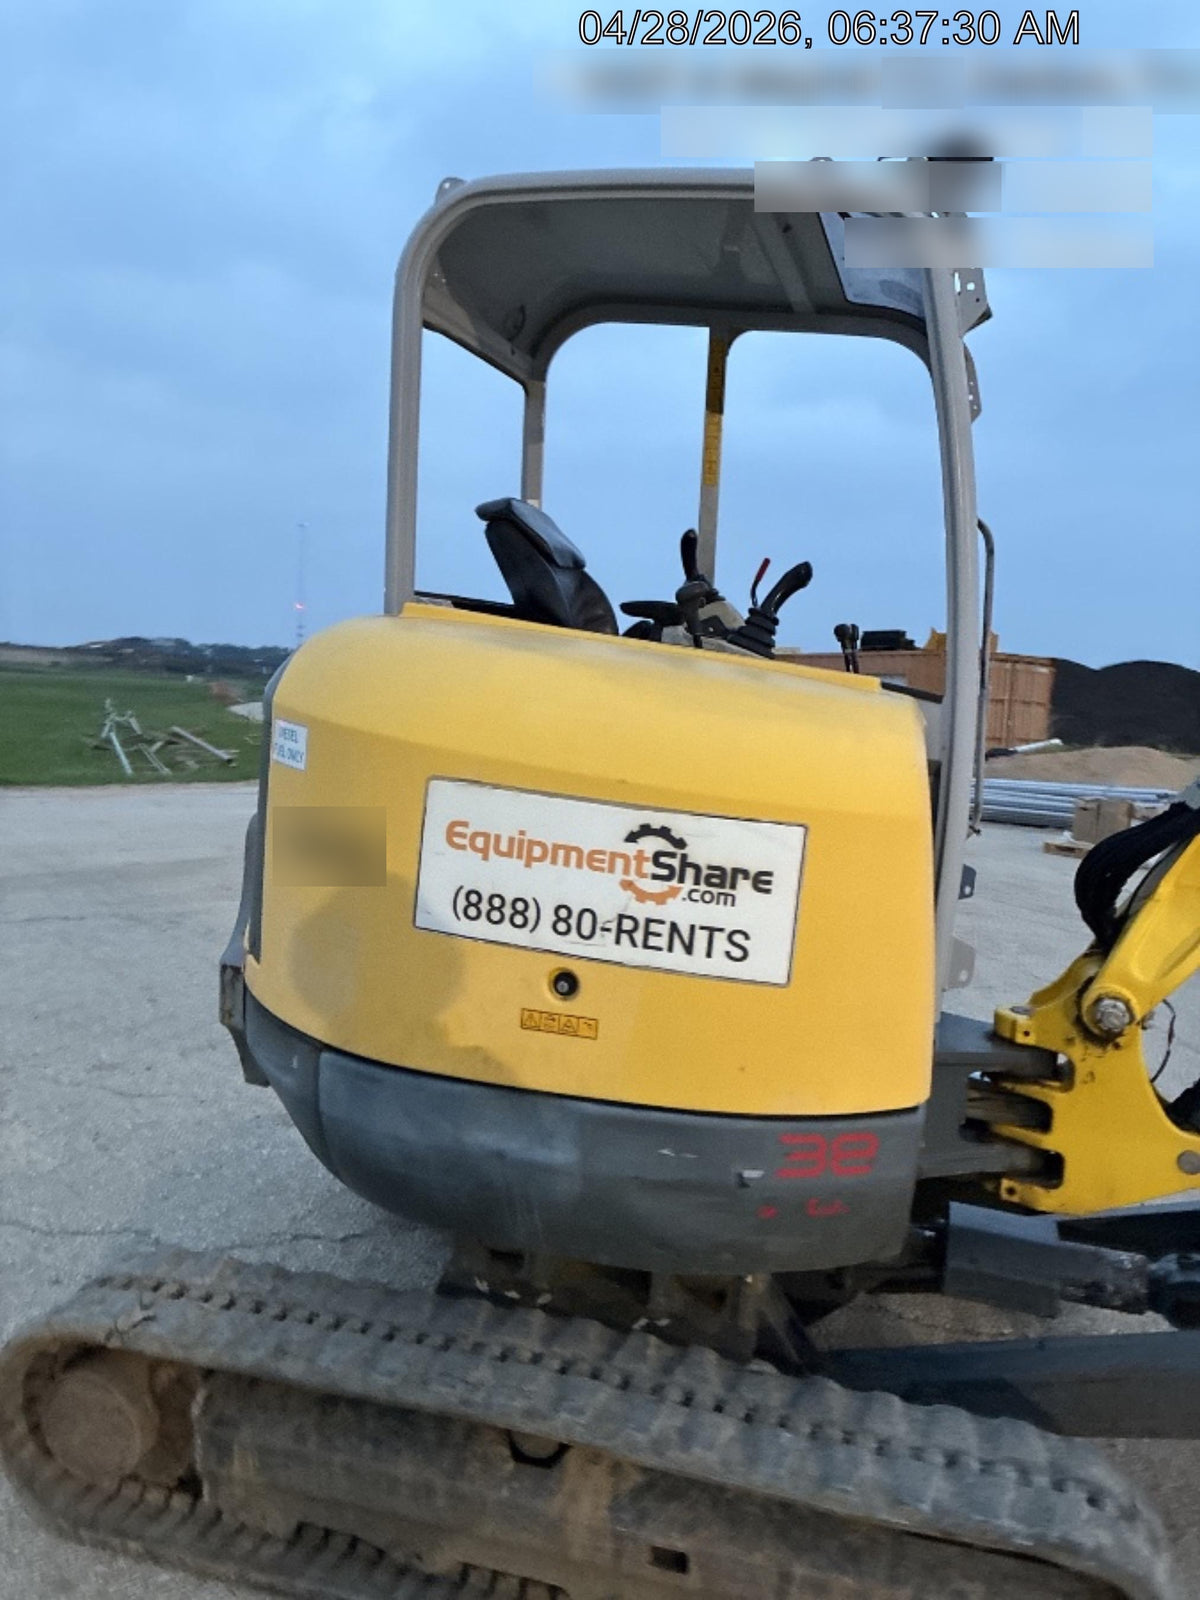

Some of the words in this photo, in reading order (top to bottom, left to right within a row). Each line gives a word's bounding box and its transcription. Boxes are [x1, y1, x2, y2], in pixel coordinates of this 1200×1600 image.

[445, 820, 774, 894] EquipmentShare
[453, 885, 541, 933] (888)
[551, 904, 751, 963] 80-RENTS
[681, 888, 737, 907] .com
